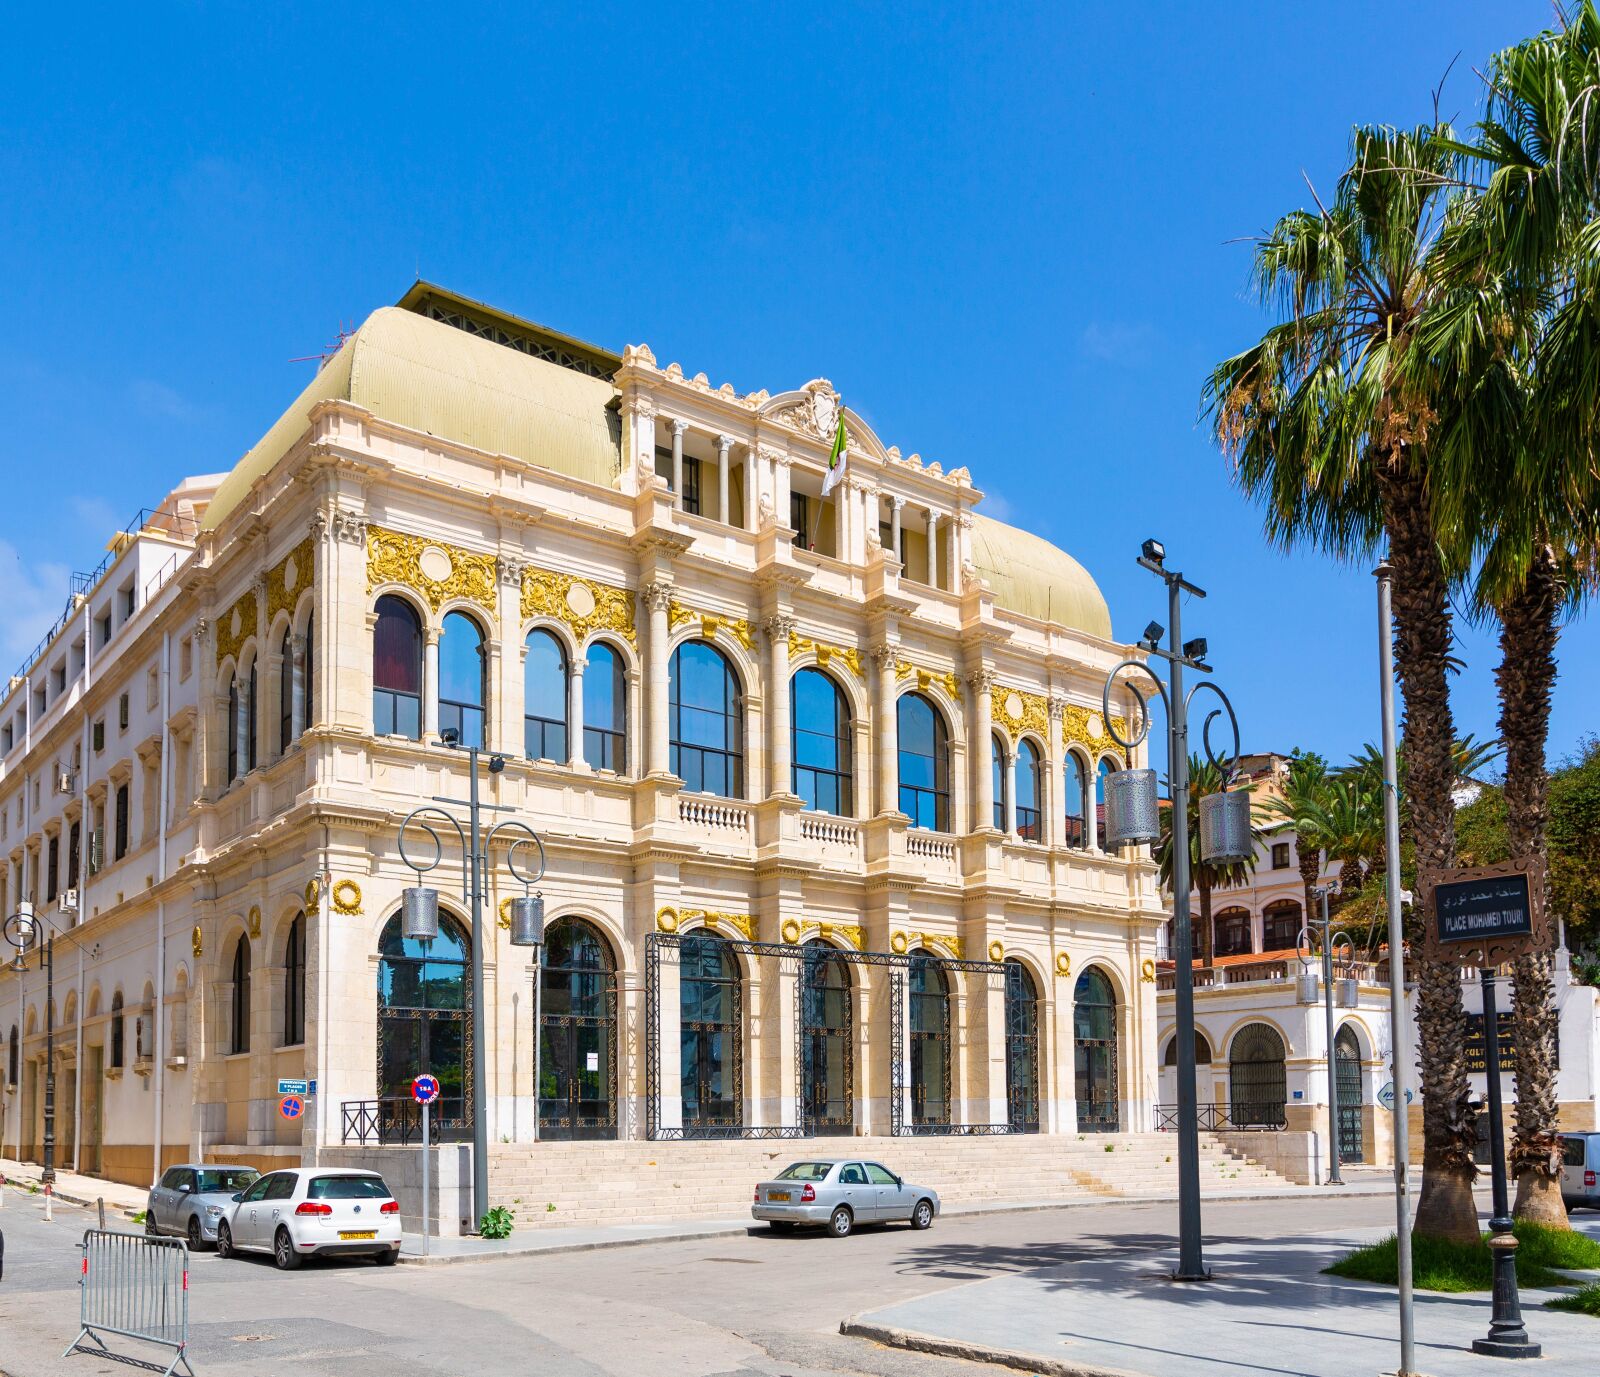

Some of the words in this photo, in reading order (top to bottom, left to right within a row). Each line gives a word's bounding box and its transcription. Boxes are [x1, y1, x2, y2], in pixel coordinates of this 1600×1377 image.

[1445, 914, 1467, 932] PLACE
[1467, 910, 1502, 930] MOHAMED
[1502, 908, 1524, 926] TOURI
